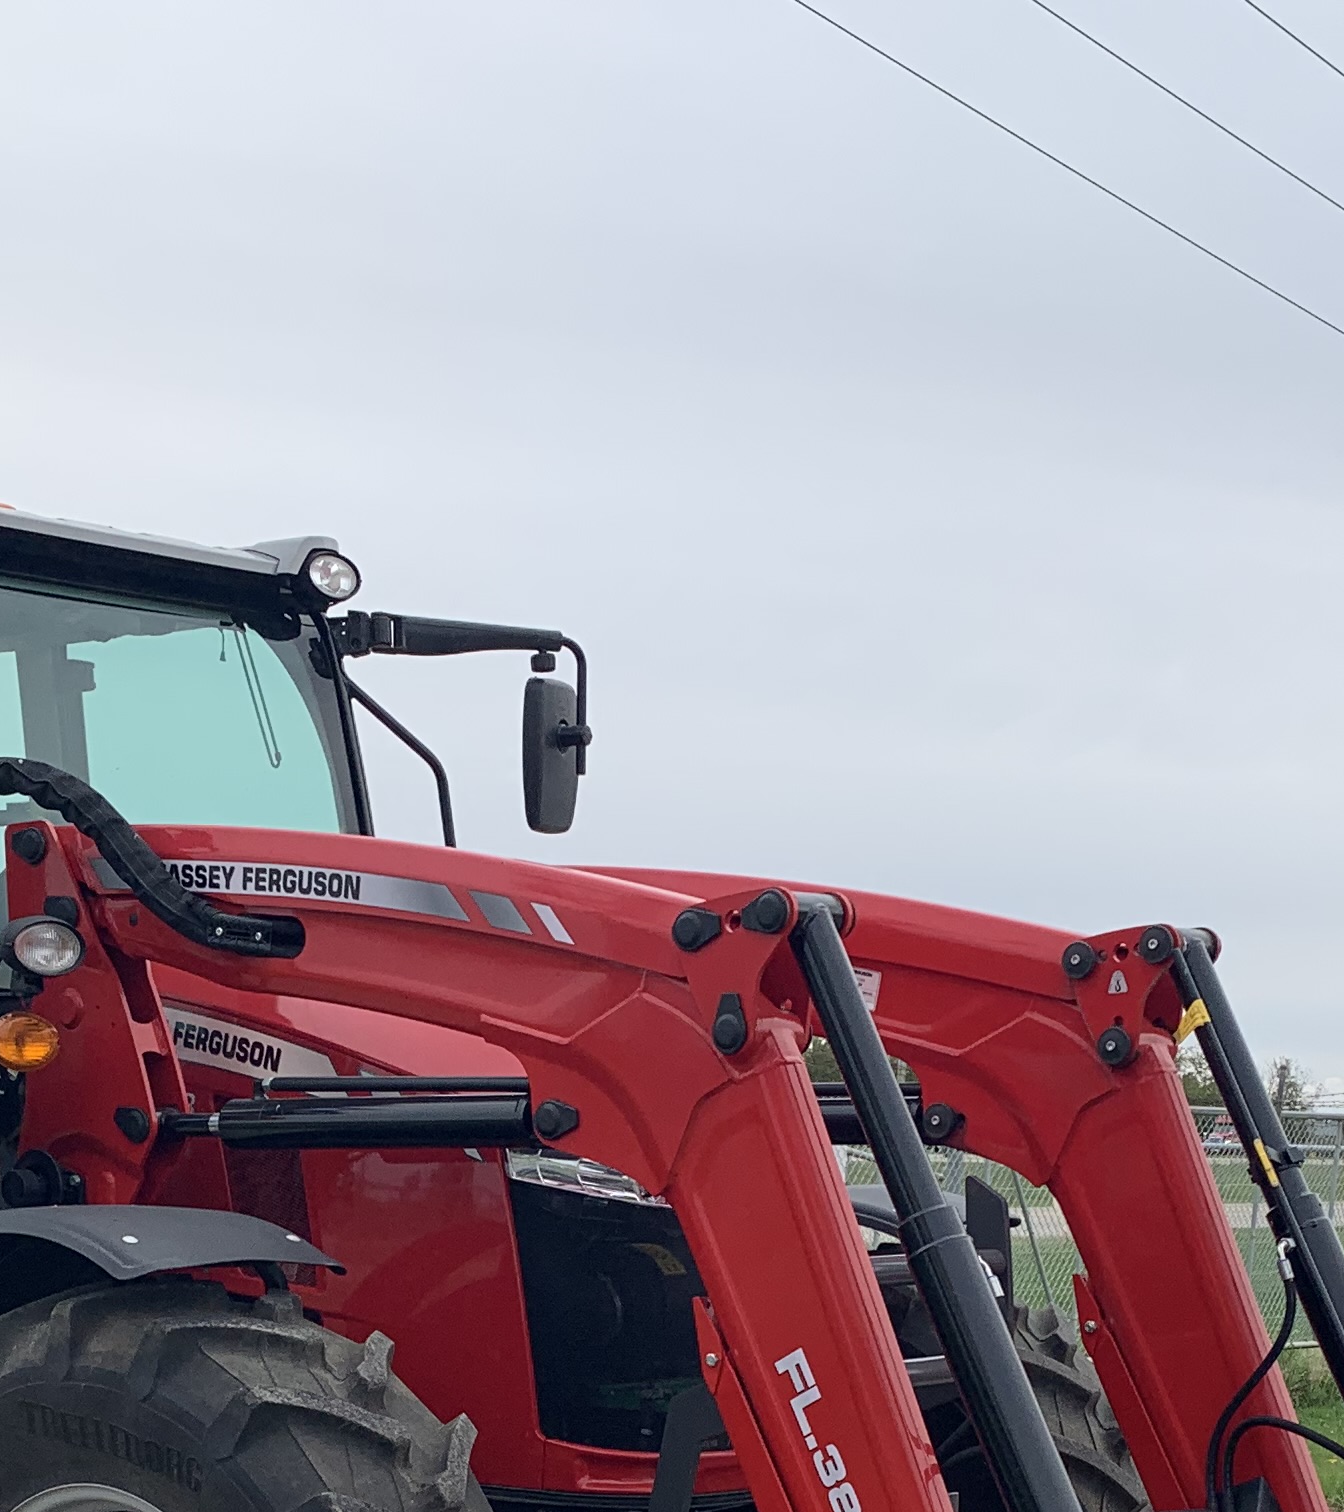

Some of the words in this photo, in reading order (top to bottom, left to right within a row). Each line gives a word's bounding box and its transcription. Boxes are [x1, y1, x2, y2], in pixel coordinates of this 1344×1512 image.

[163, 863, 236, 891] ASSEY
[242, 866, 361, 901] FERGUSON
[173, 1020, 282, 1074] FERGUSON
